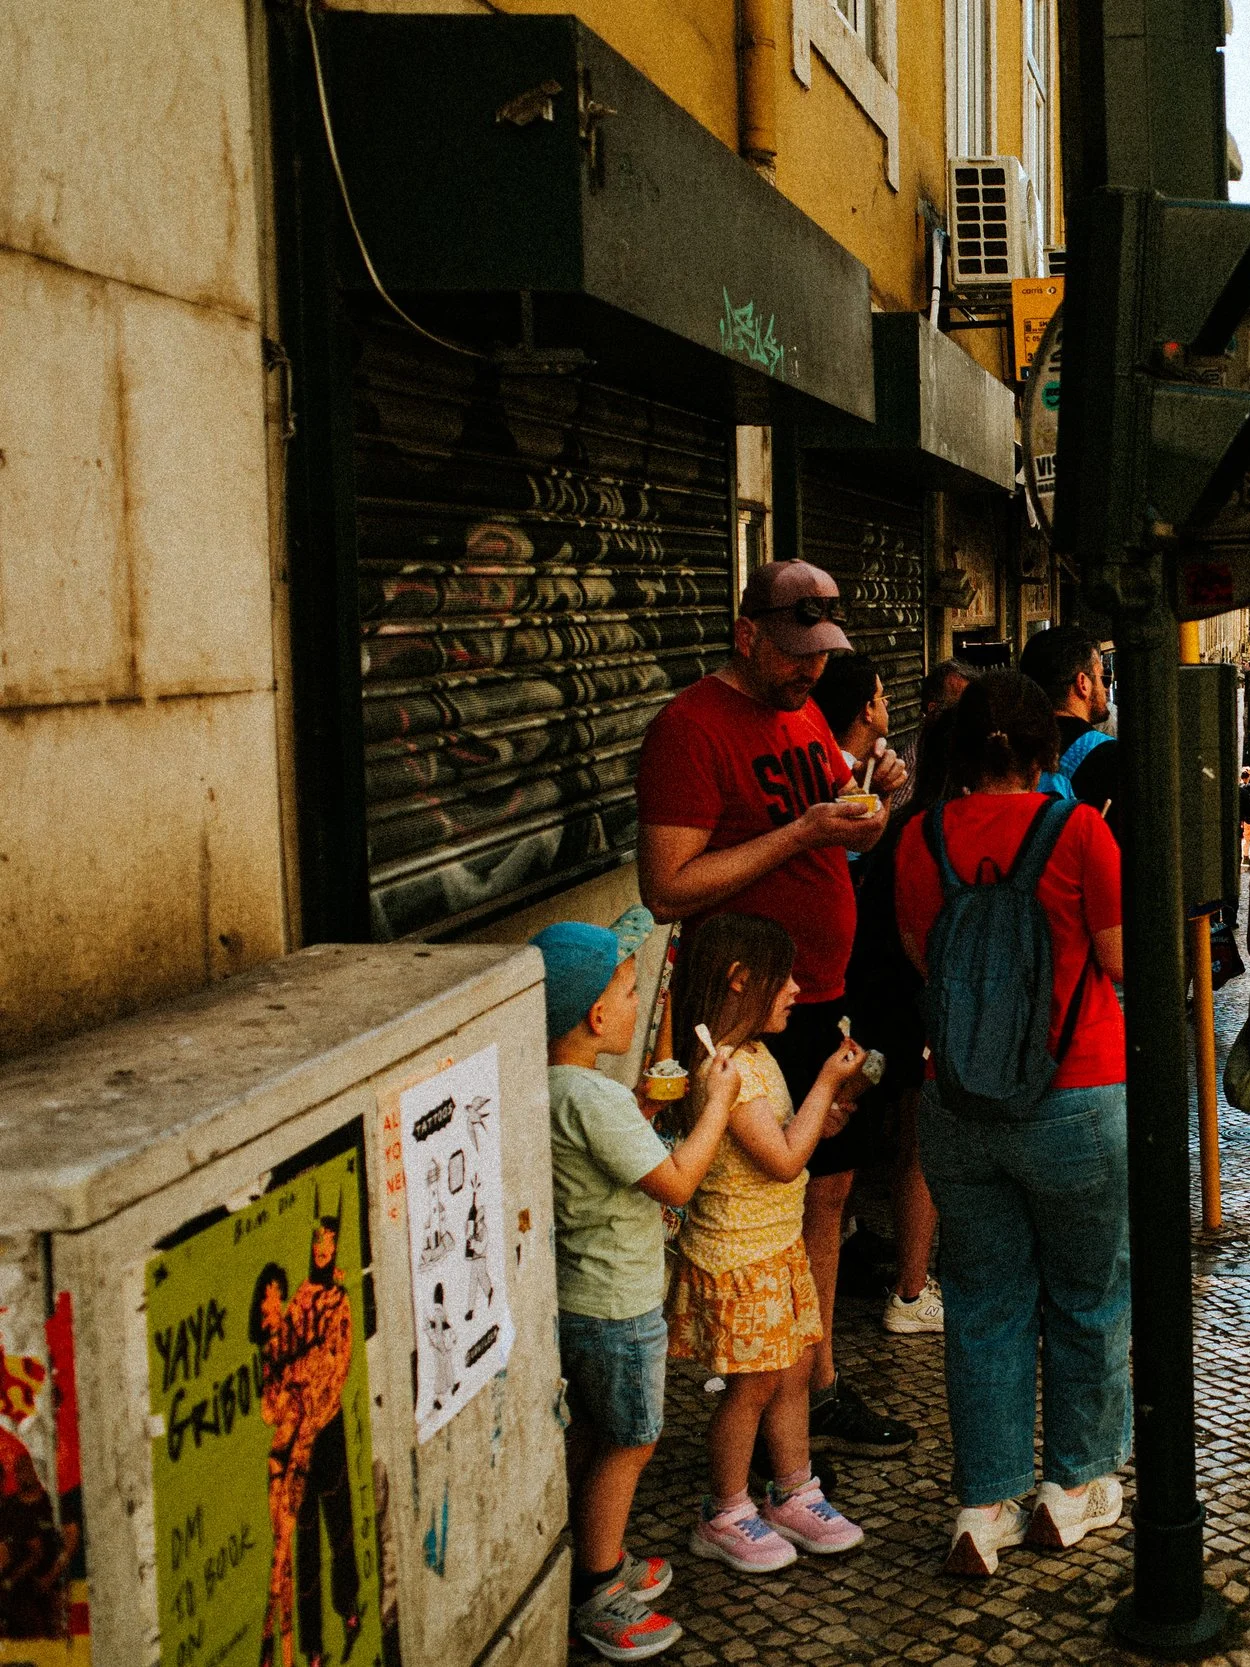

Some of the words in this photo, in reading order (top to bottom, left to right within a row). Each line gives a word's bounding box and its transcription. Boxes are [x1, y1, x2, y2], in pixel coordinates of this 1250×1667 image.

[1021, 287, 1043, 295] carris
[415, 1102, 453, 1136] TATTOOS
[154, 1298, 227, 1394] YAYA
[203, 1523, 256, 1601] BOOK
